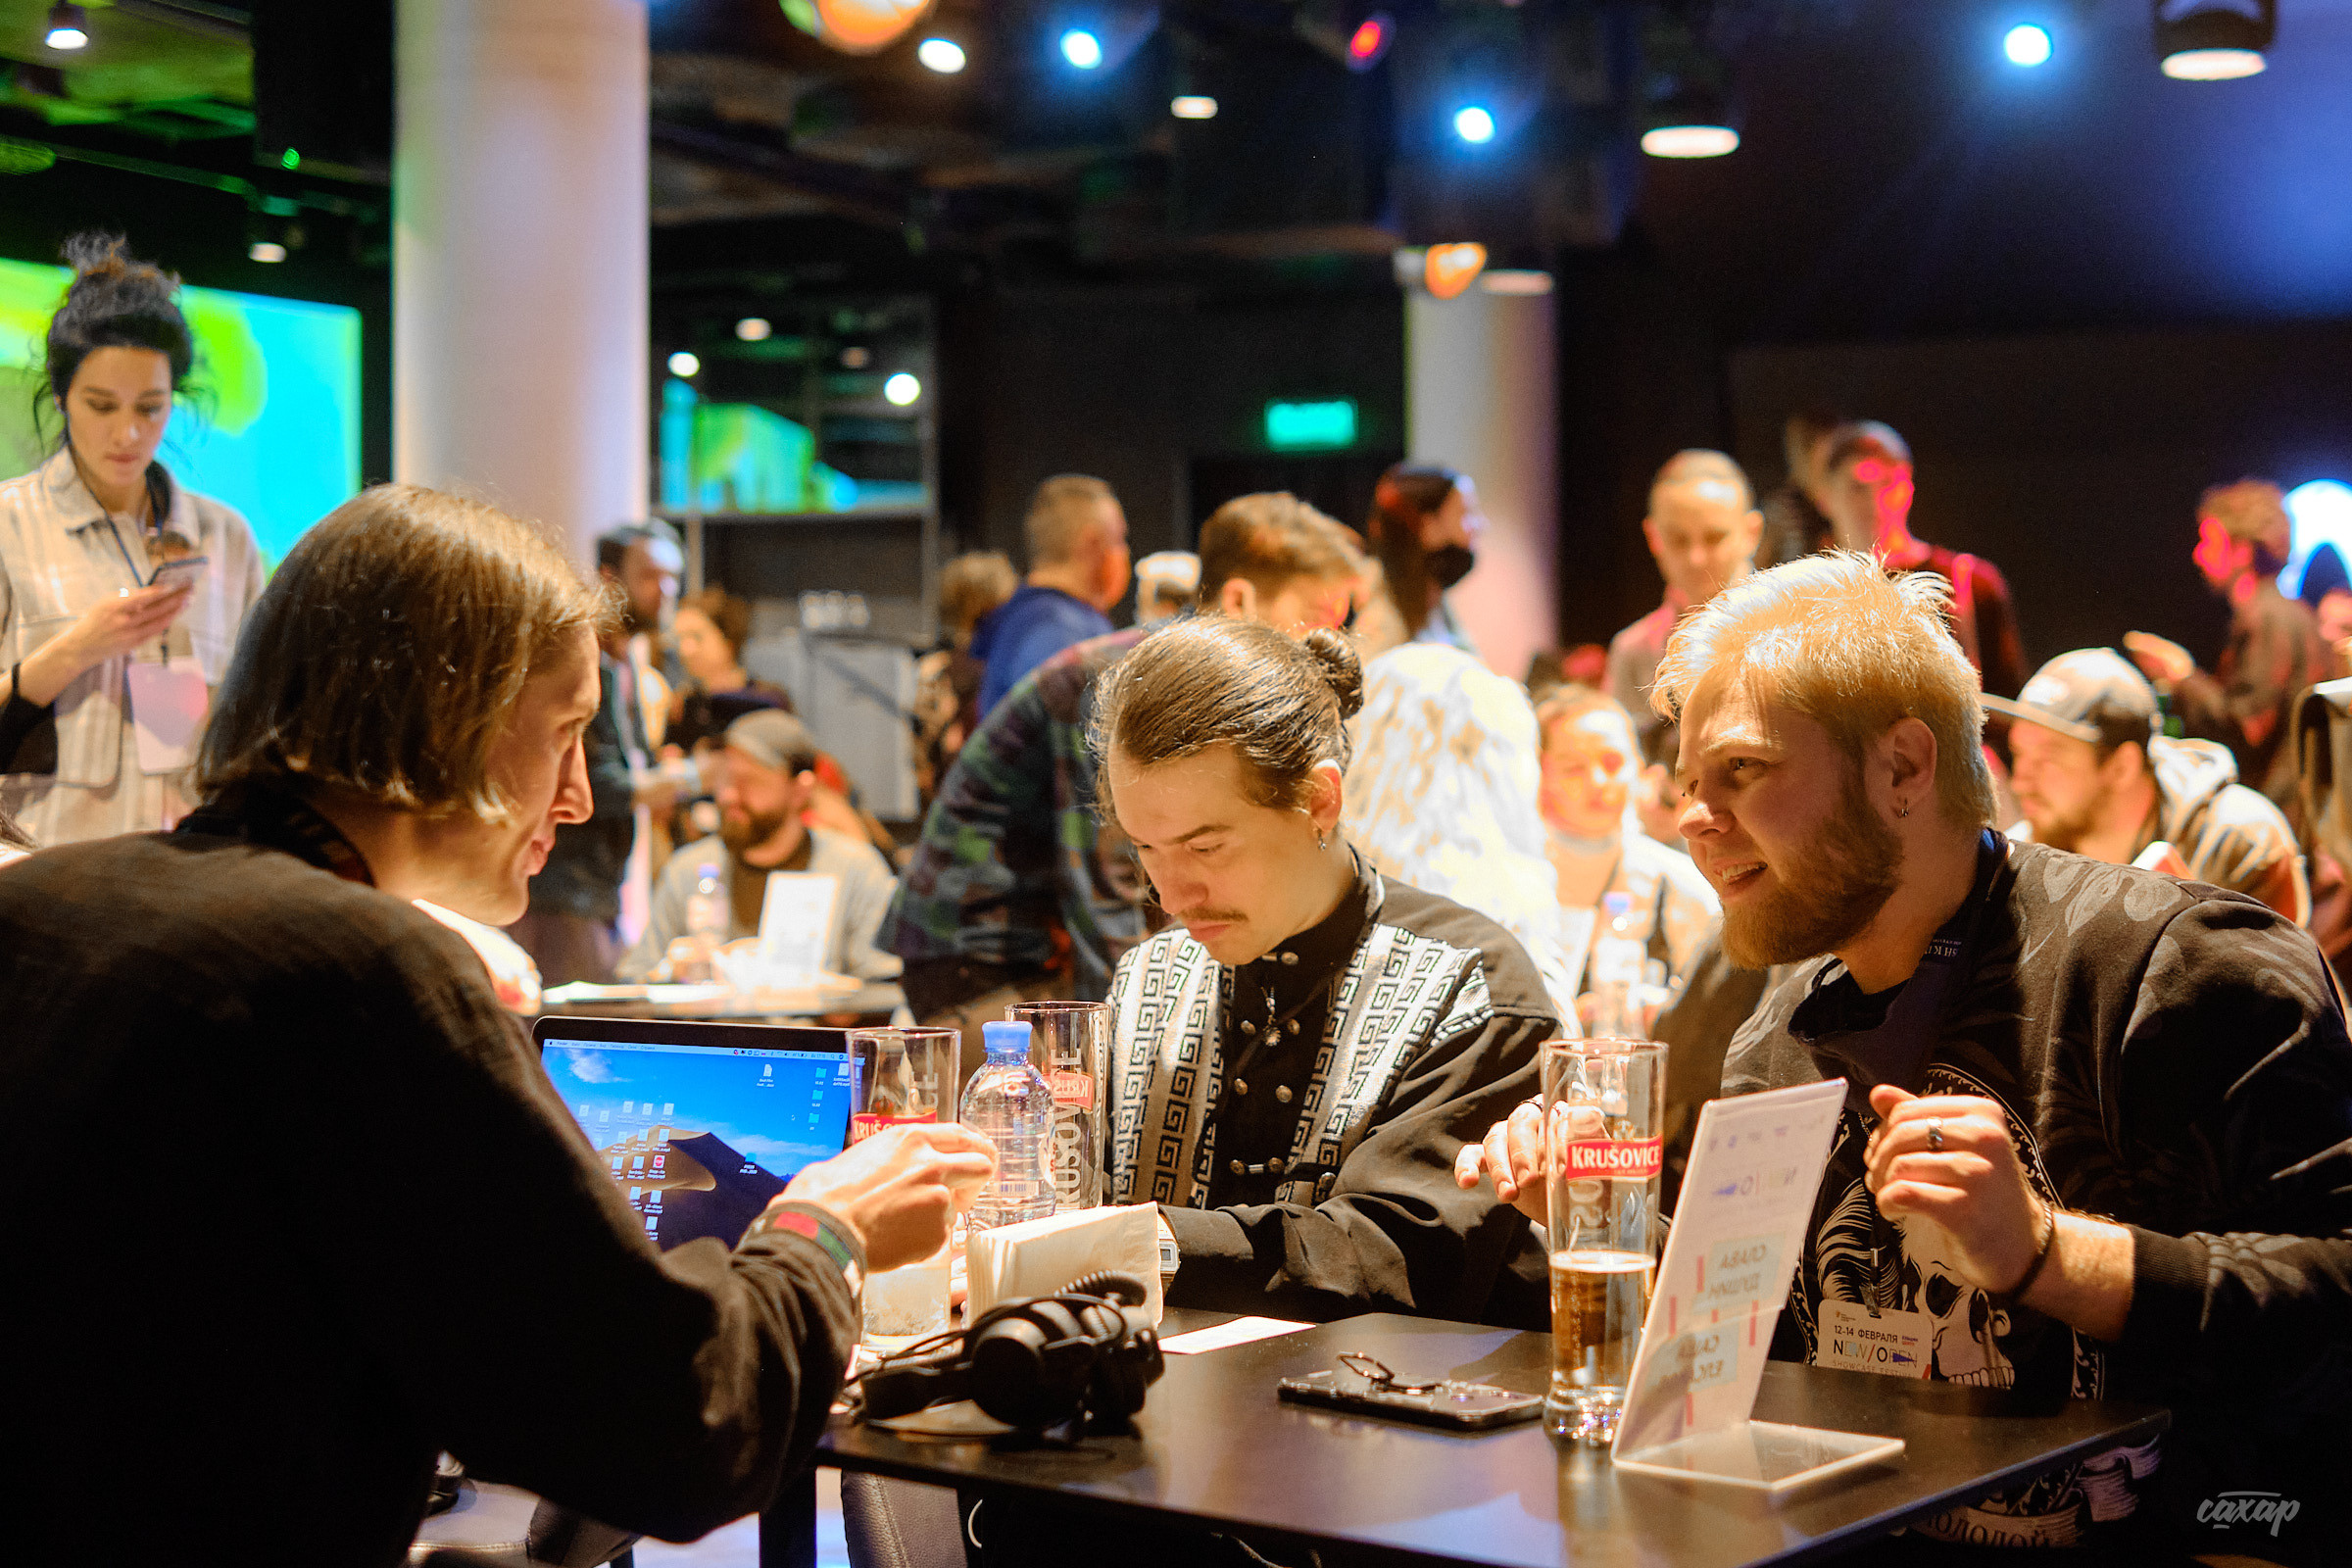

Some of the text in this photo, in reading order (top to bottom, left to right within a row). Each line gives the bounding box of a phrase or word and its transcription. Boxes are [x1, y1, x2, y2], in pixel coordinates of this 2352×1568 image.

[1571, 1144, 1660, 1170] KRUŠOVICE
[1834, 1324, 1854, 1337] 12-14
[1857, 1329, 1898, 1344] ФЕВРАЛЯ
